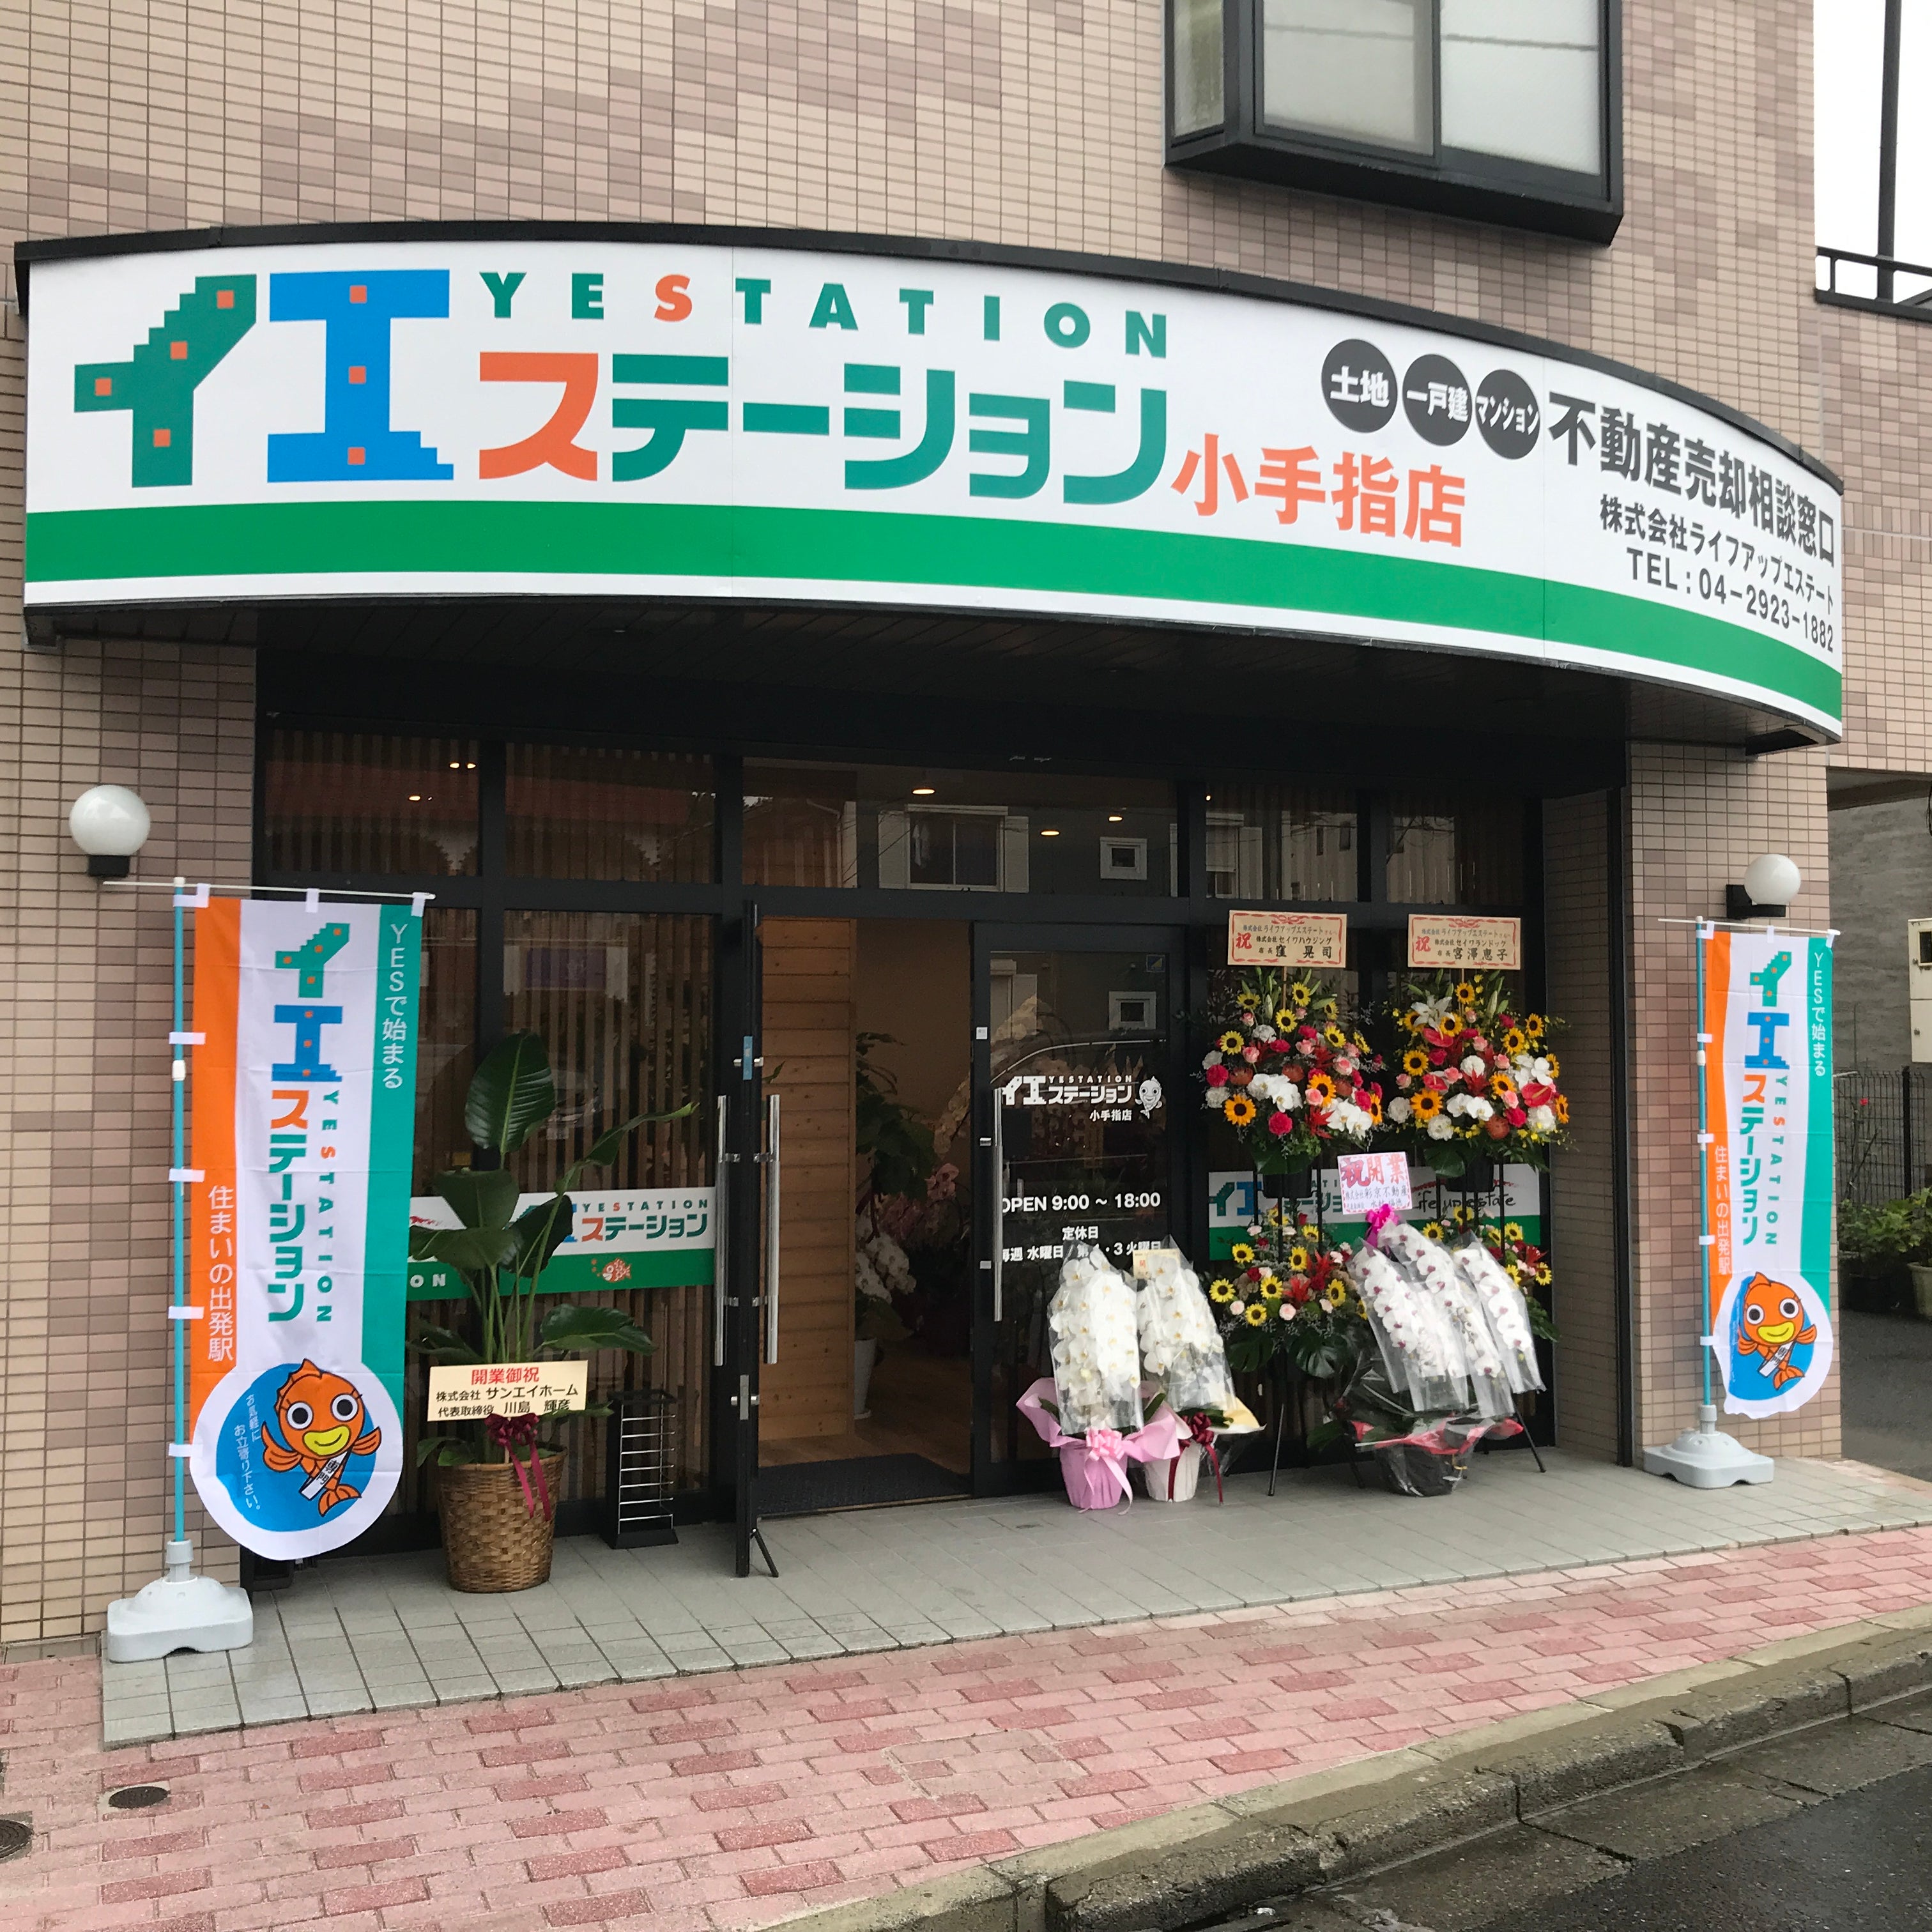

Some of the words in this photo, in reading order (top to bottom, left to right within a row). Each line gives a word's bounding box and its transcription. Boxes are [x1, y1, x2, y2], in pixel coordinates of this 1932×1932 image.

[479, 272, 1167, 358] YESTATION
[1330, 366, 1390, 408] 土地
[1406, 381, 1469, 422] 一戸建
[1475, 395, 1539, 436] マンション
[1172, 433, 1466, 548] 小手指店
[1547, 391, 1835, 568] 不動産売却相談窓口
[1600, 494, 1834, 615] 株式会社ライフアップエステート
[1236, 932, 1252, 949] 祝
[1279, 936, 1332, 944] セイワハウジング
[1415, 936, 1430, 952] 祝
[382, 924, 408, 1089] YESで始まる
[1811, 952, 1826, 1077] YESで始まる
[1048, 1075, 1132, 1084] YESTATION
[1089, 1109, 1132, 1122] 小手指店
[1765, 1075, 1788, 1245] YESTATION
[316, 1090, 339, 1322] YESTATION
[582, 1199, 708, 1213] YESTATION
[1052, 1194, 1089, 1211] 9:00
[1114, 1192, 1161, 1208] 18:00
[1715, 1146, 1732, 1275] 住まいの出発駅
[1062, 1225, 1099, 1241] 定休日
[208, 1185, 234, 1362] 住まいの出発駅
[436, 1390, 480, 1402] 株式会社
[486, 1384, 578, 1400] サンエイホーム
[471, 1367, 540, 1386] 開業御祝
